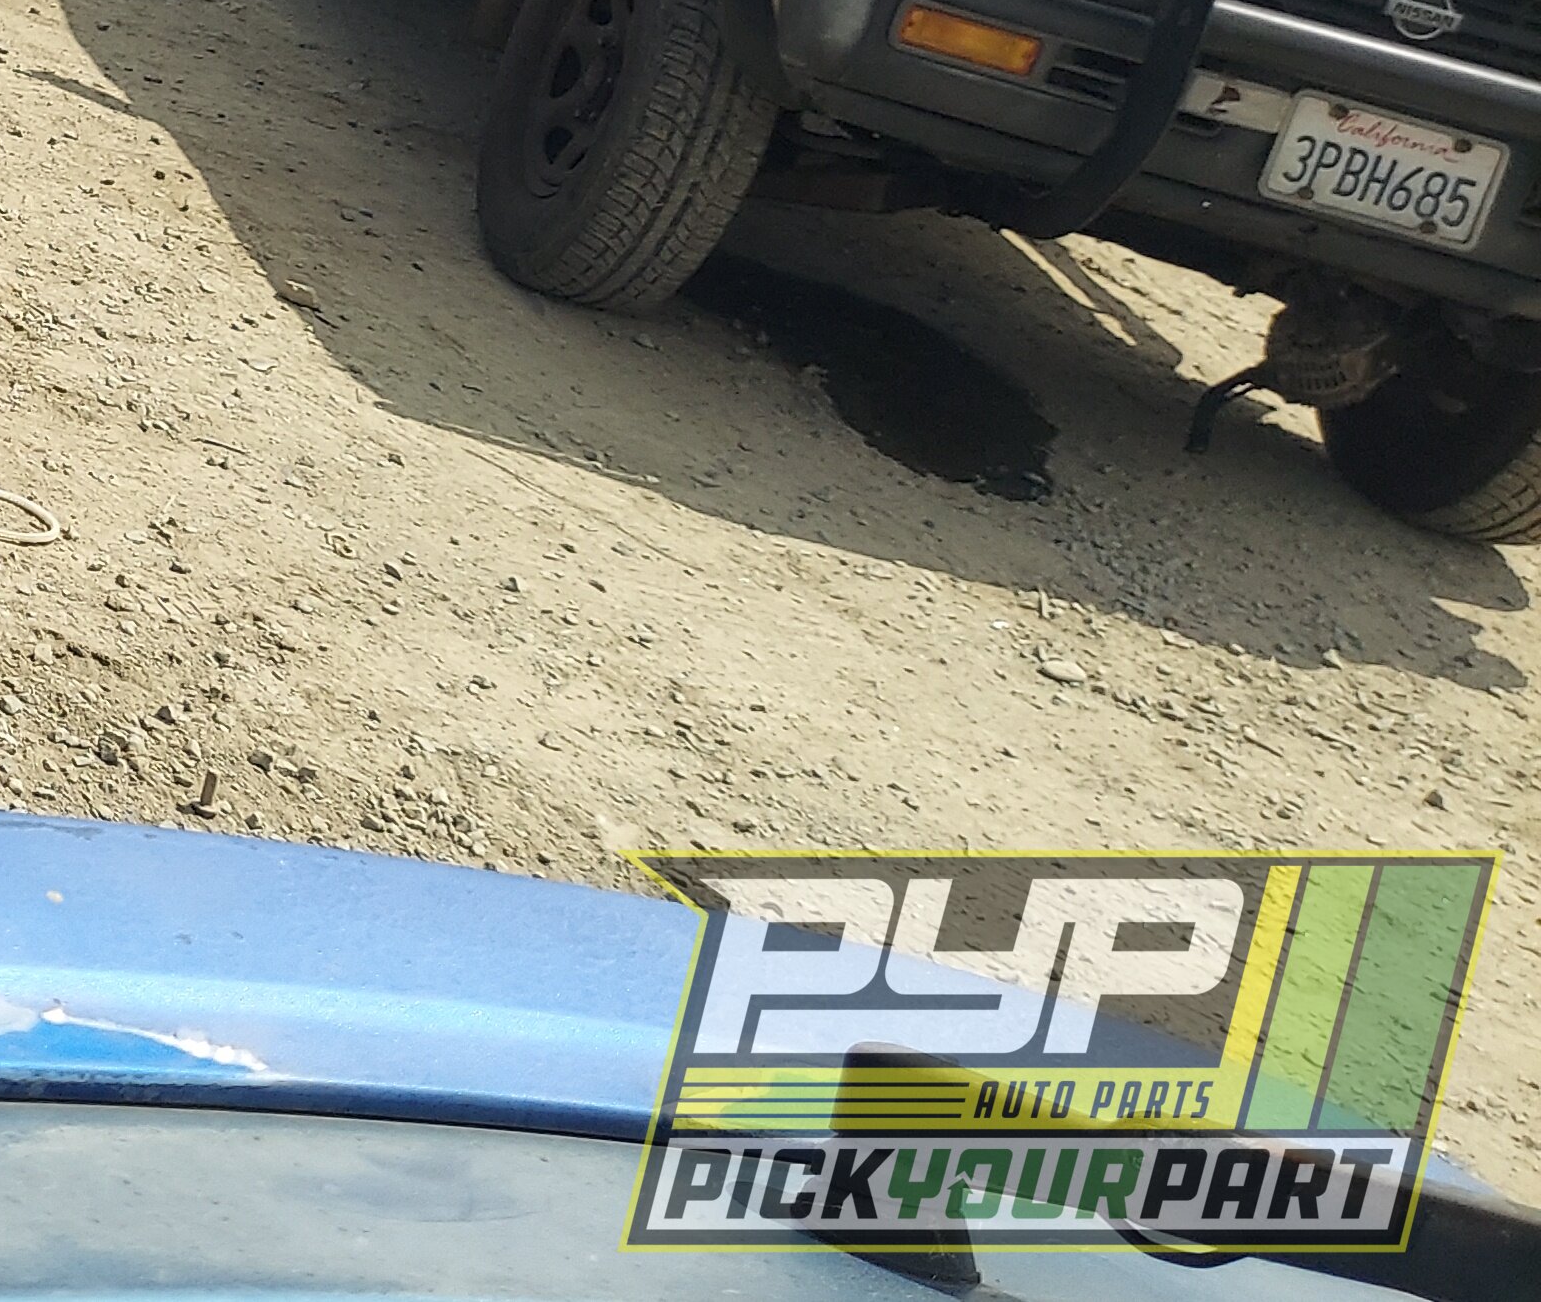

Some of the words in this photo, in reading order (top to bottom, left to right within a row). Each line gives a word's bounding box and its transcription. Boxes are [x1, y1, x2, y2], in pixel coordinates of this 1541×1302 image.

[1392, 0, 1456, 30] NISSAN
[1336, 112, 1460, 164] California
[1283, 135, 1476, 227] 3PBH685
